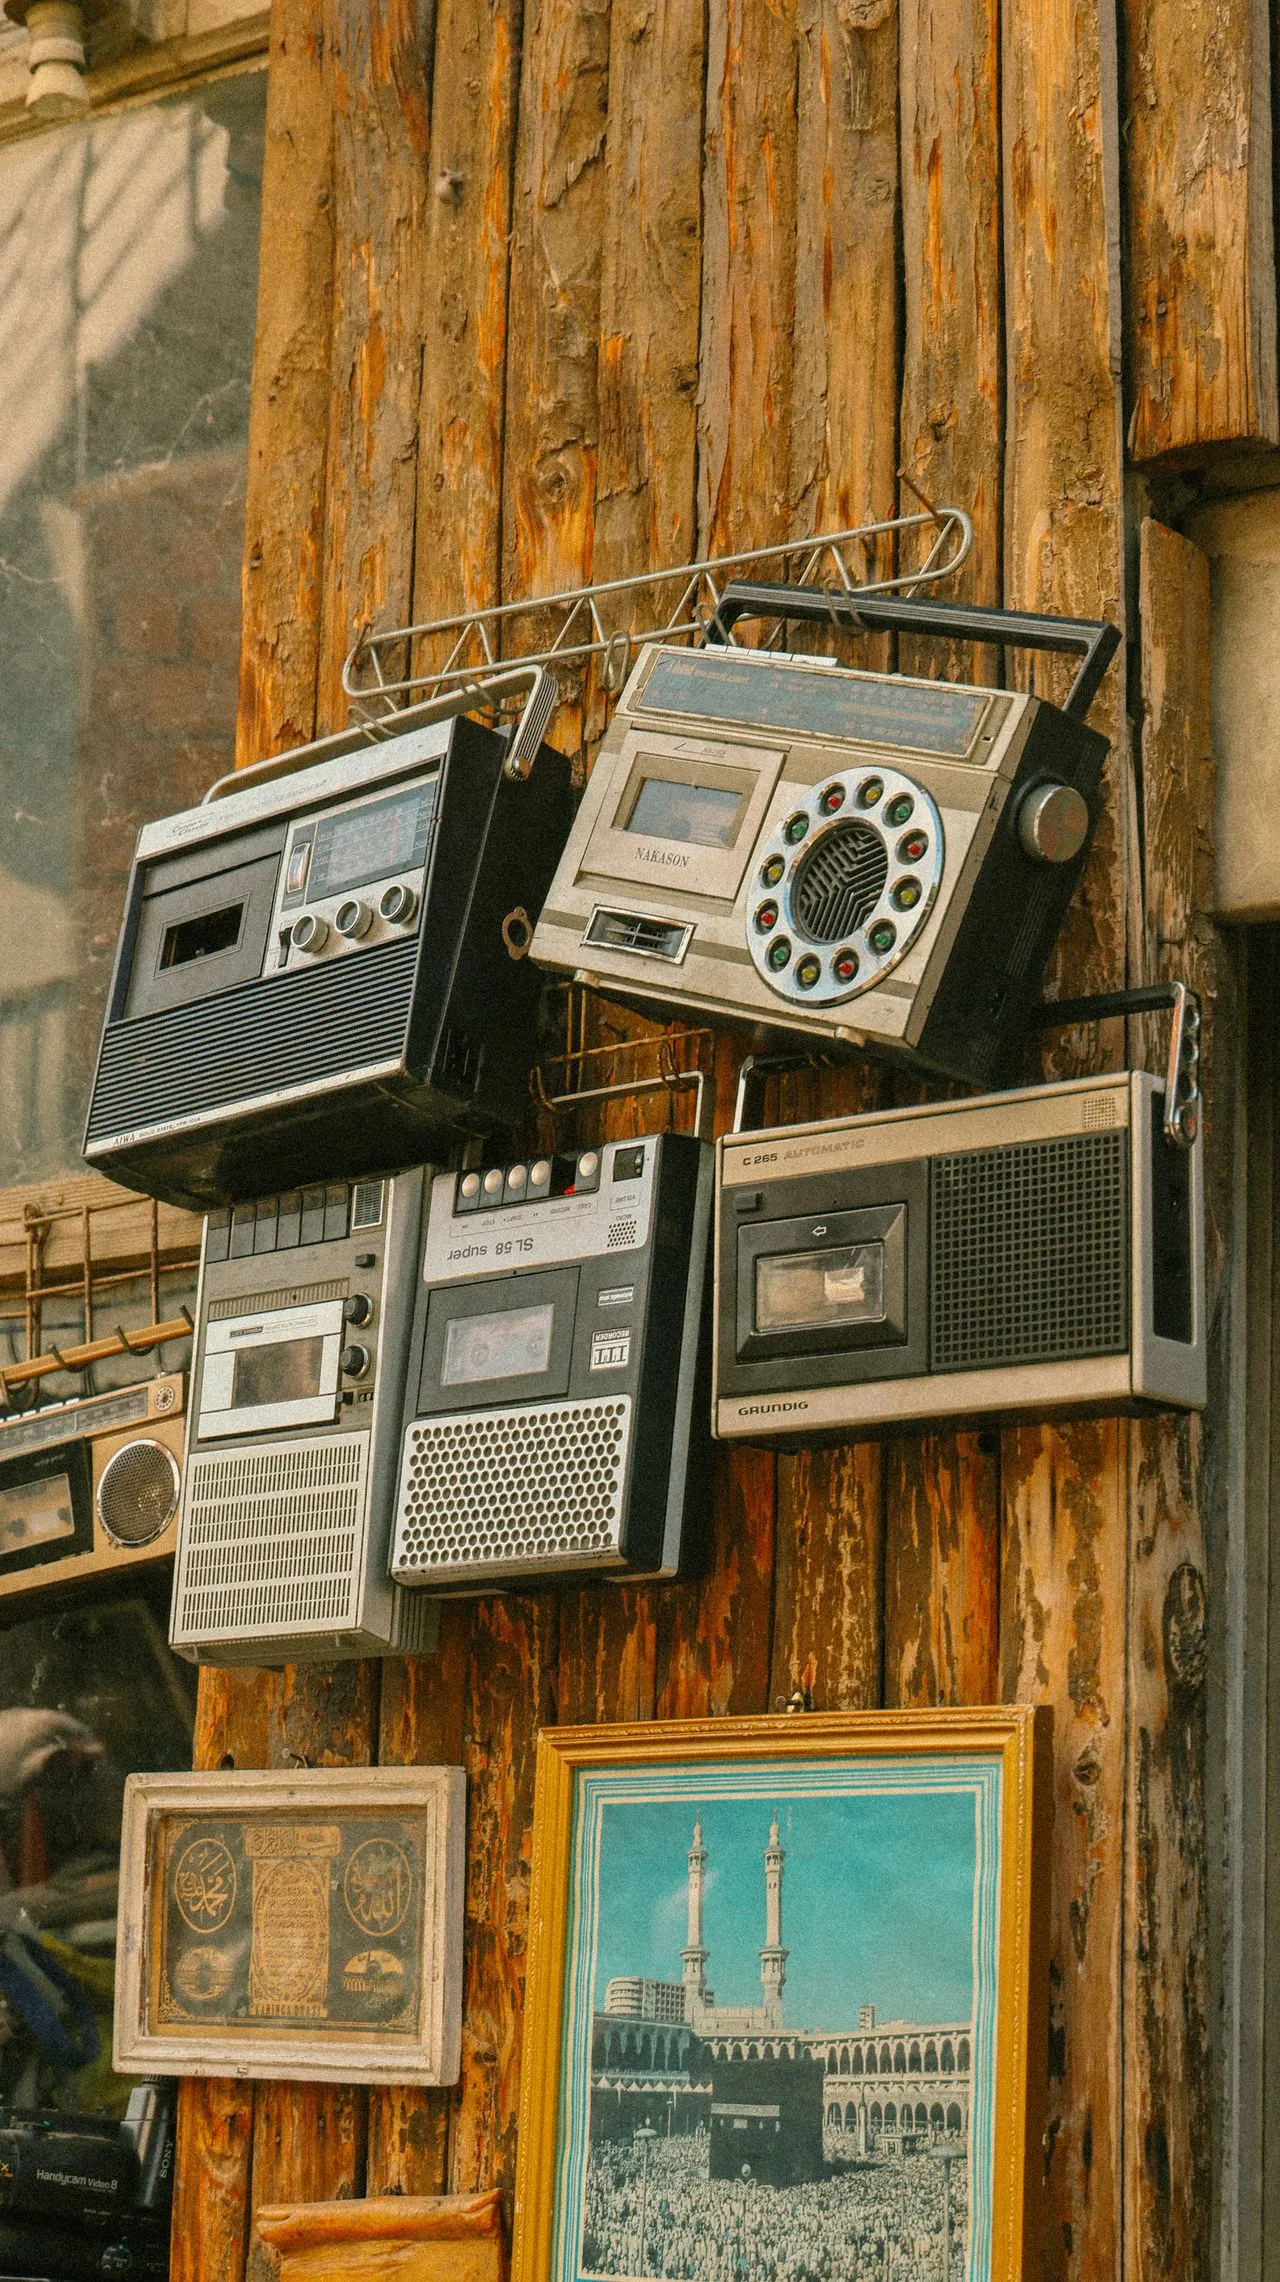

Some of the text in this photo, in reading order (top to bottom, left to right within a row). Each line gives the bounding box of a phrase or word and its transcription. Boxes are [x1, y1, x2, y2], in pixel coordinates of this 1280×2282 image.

[634, 847, 690, 868] NAKASON
[113, 1134, 135, 1146] AIWA
[742, 1138, 865, 1166] C 265 AUTOMATIC
[447, 1237, 534, 1261] SL 58 super
[595, 1329, 630, 1342] RECORDER
[738, 1400, 809, 1416] GRUNDIG
[160, 2140, 173, 2178] SONY
[36, 2168, 87, 2186] Handycam
